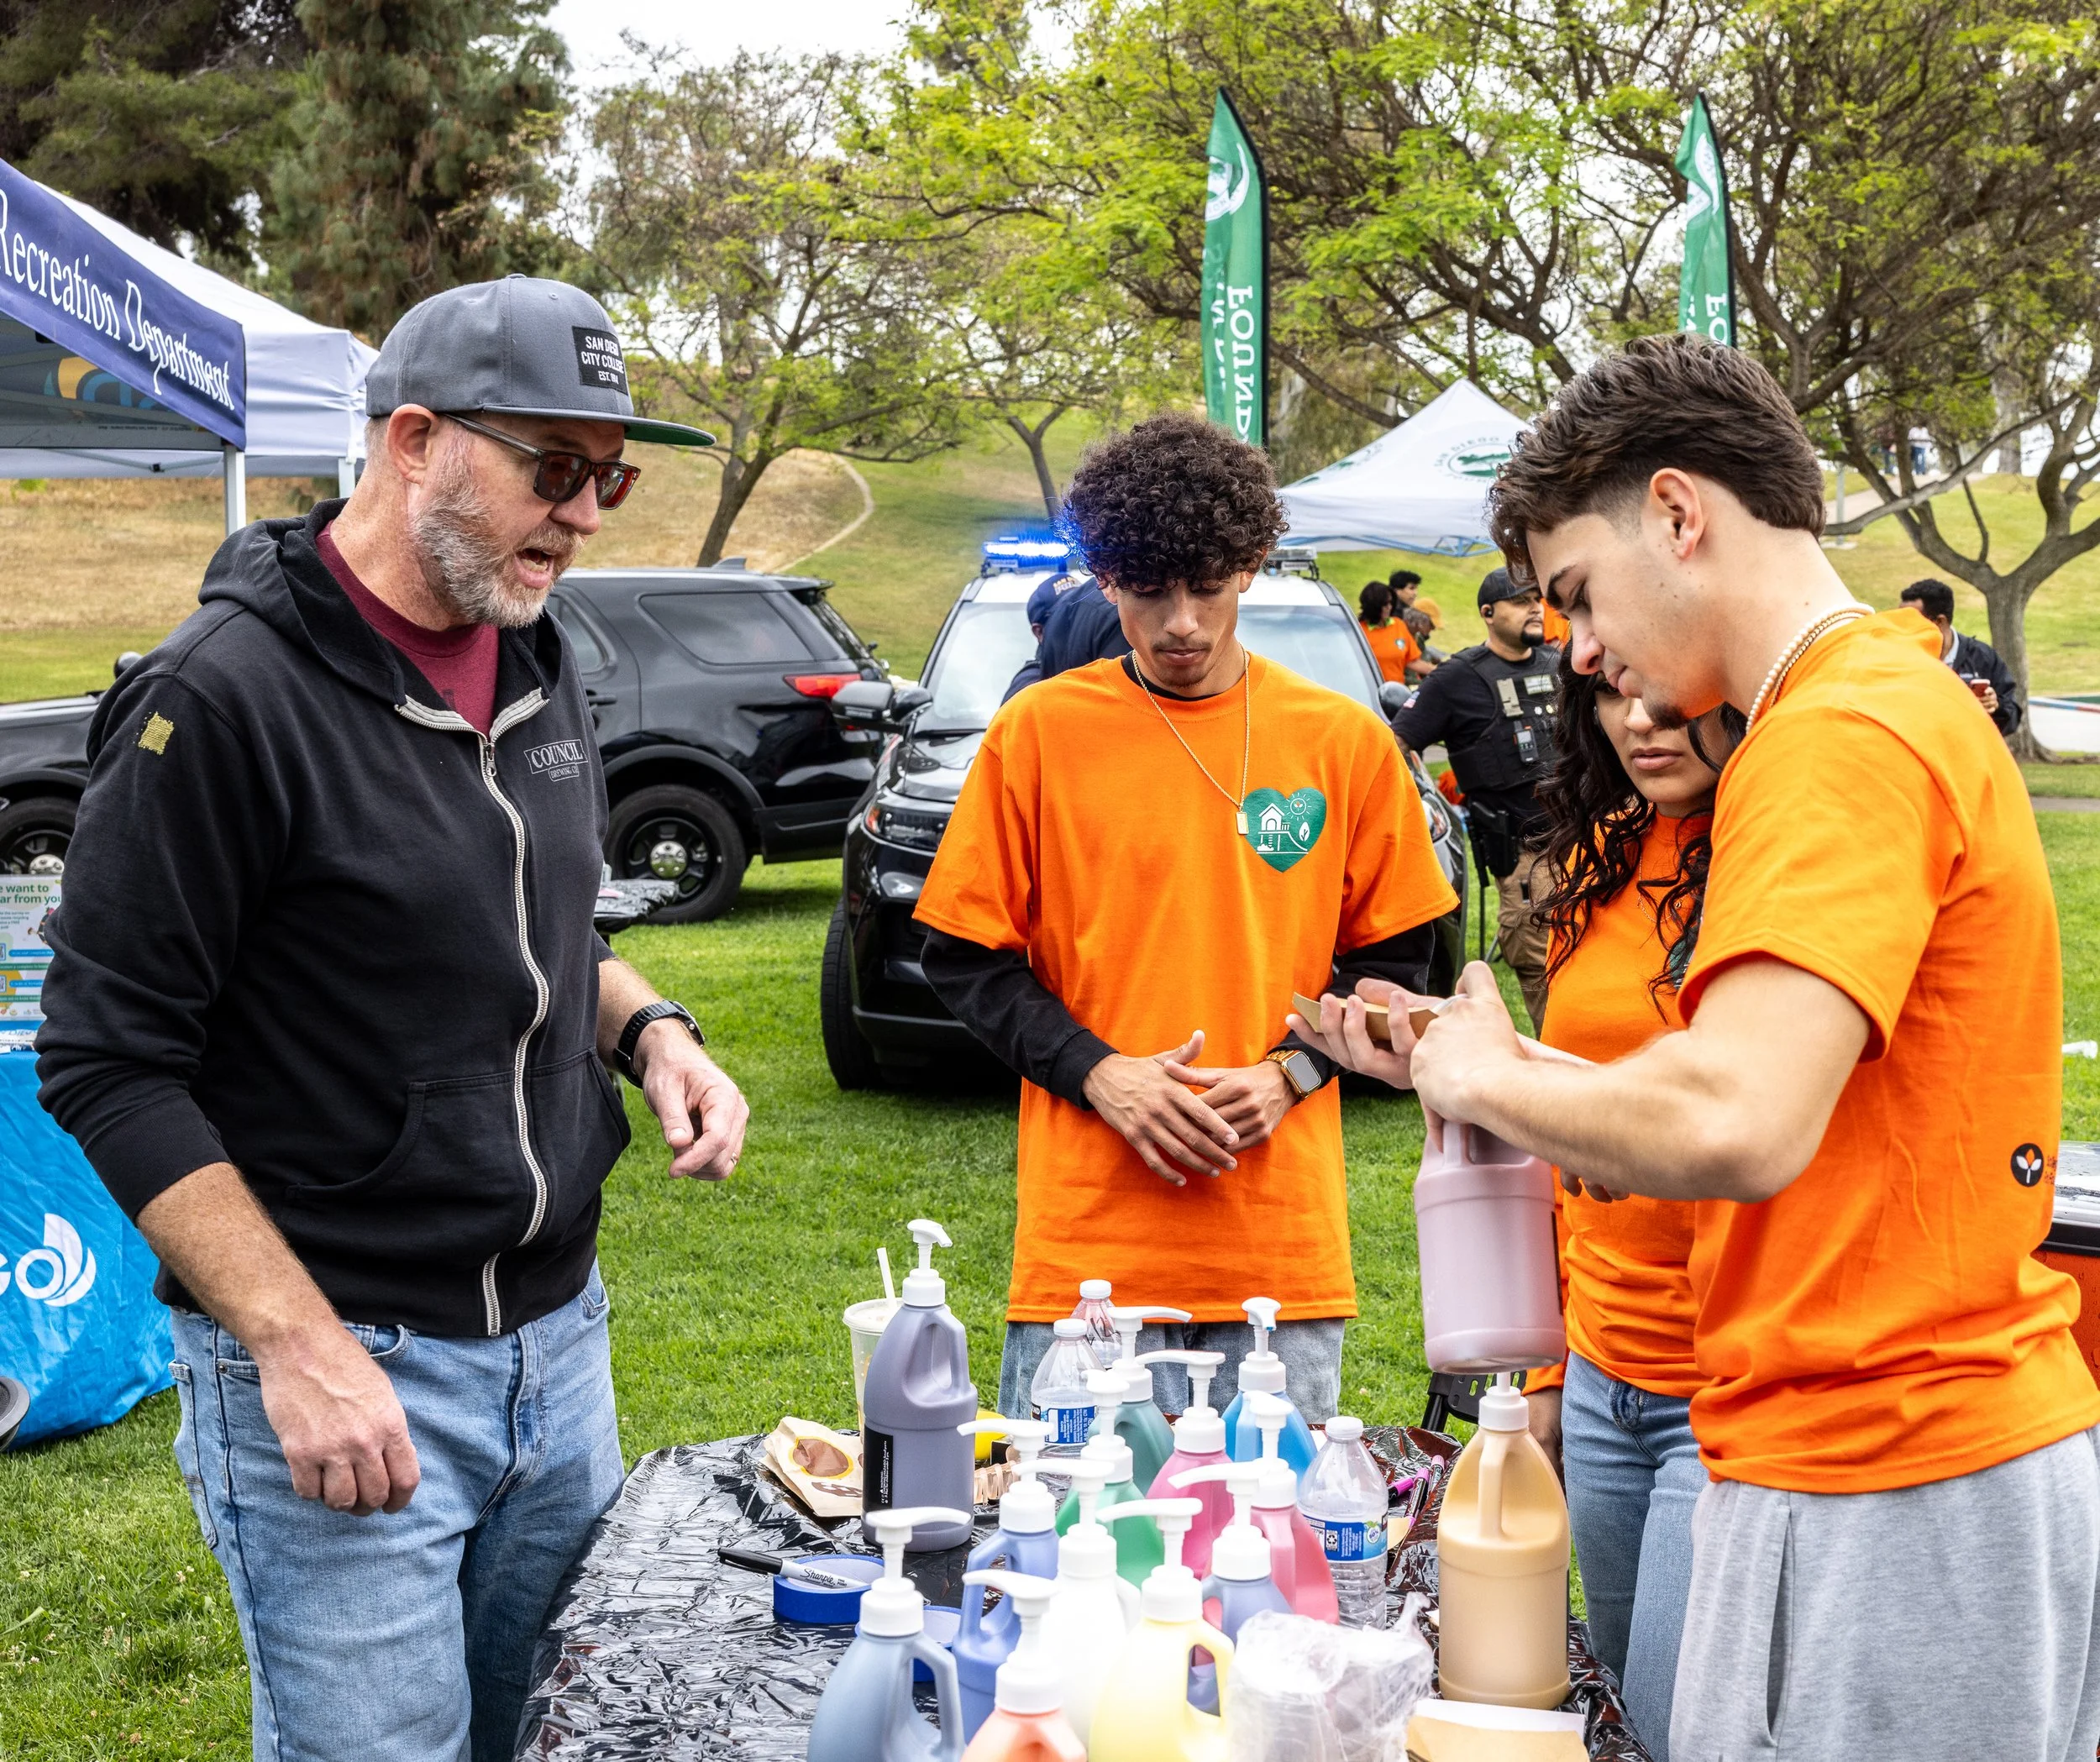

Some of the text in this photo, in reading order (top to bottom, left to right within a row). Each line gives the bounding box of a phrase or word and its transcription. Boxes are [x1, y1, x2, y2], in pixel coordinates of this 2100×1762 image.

[124, 279, 235, 411] Department
[585, 335, 605, 351] SAN
[580, 351, 601, 366] CITY
[531, 742, 583, 768] COUNCIL
[549, 767, 571, 779] BREWING
[6, 884, 34, 893] want
[38, 884, 50, 893] to
[14, 894, 42, 904] from
[800, 1568, 834, 1585] Sharpie
